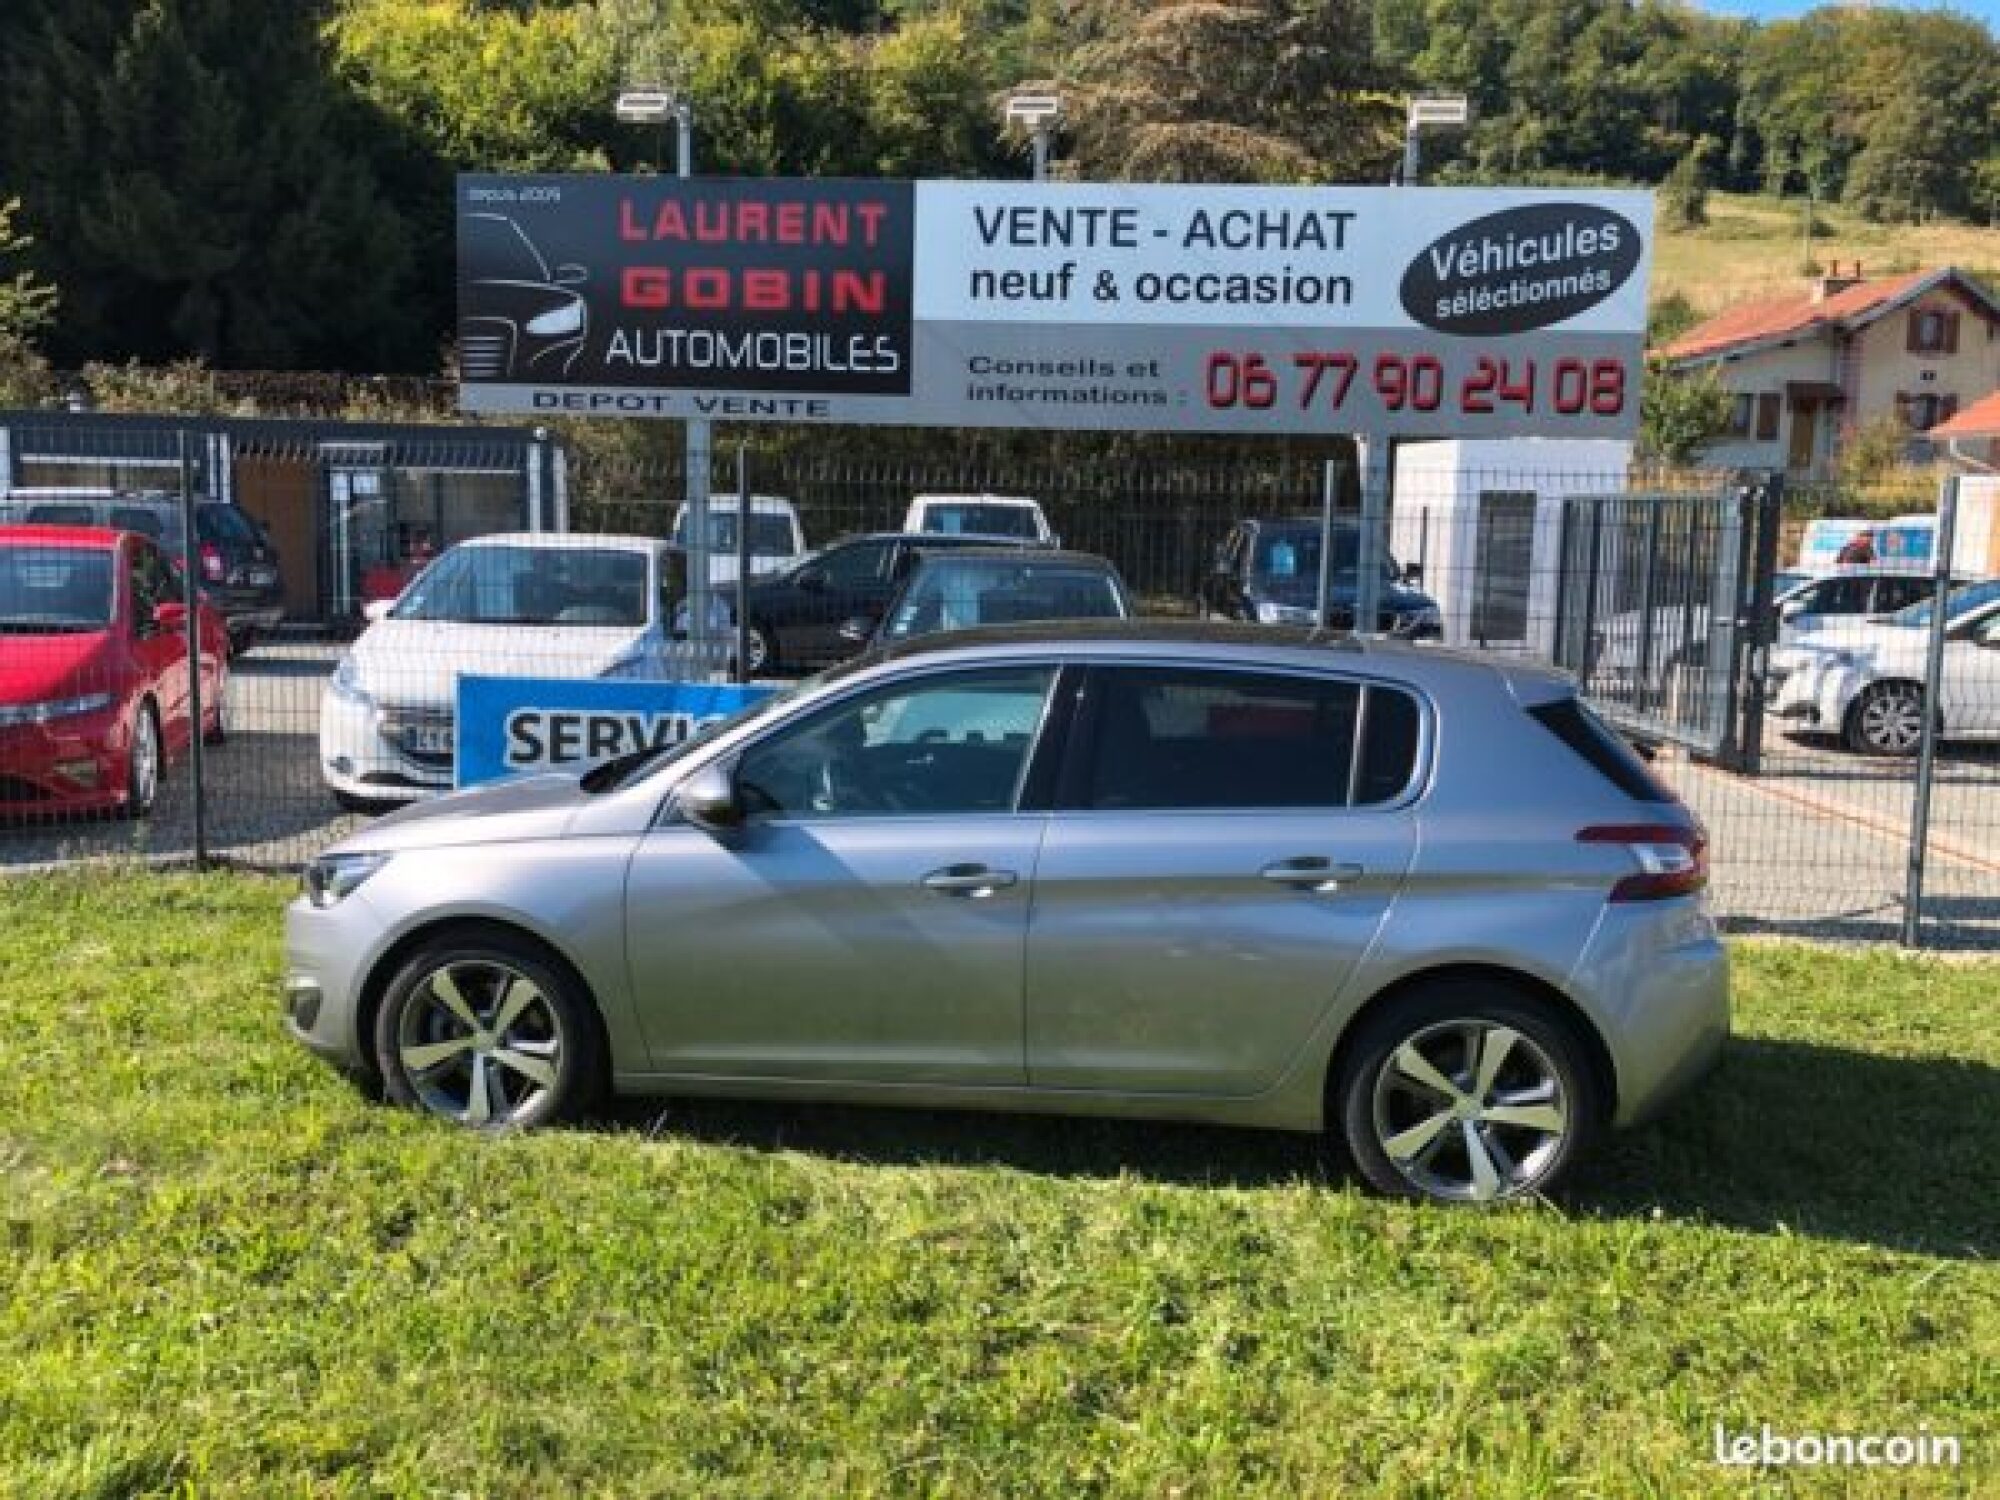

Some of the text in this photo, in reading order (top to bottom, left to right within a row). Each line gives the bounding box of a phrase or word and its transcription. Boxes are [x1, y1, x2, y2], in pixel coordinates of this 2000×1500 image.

[618, 200, 887, 245] LAURENT
[973, 206, 1139, 247] VENTE
[1182, 209, 1357, 250] ACHAT
[1430, 222, 1621, 280] Véhicules
[621, 267, 888, 312] GOBIN
[970, 261, 1354, 304] neuf & occasion
[605, 328, 900, 373] AUTOMOBILES
[968, 355, 1161, 378] Conseils et
[532, 392, 831, 417] DEPOT VENTE
[966, 383, 1167, 404] informations
[1207, 351, 1627, 416] 06 77 90 24 08
[509, 713, 714, 764] SERVI
